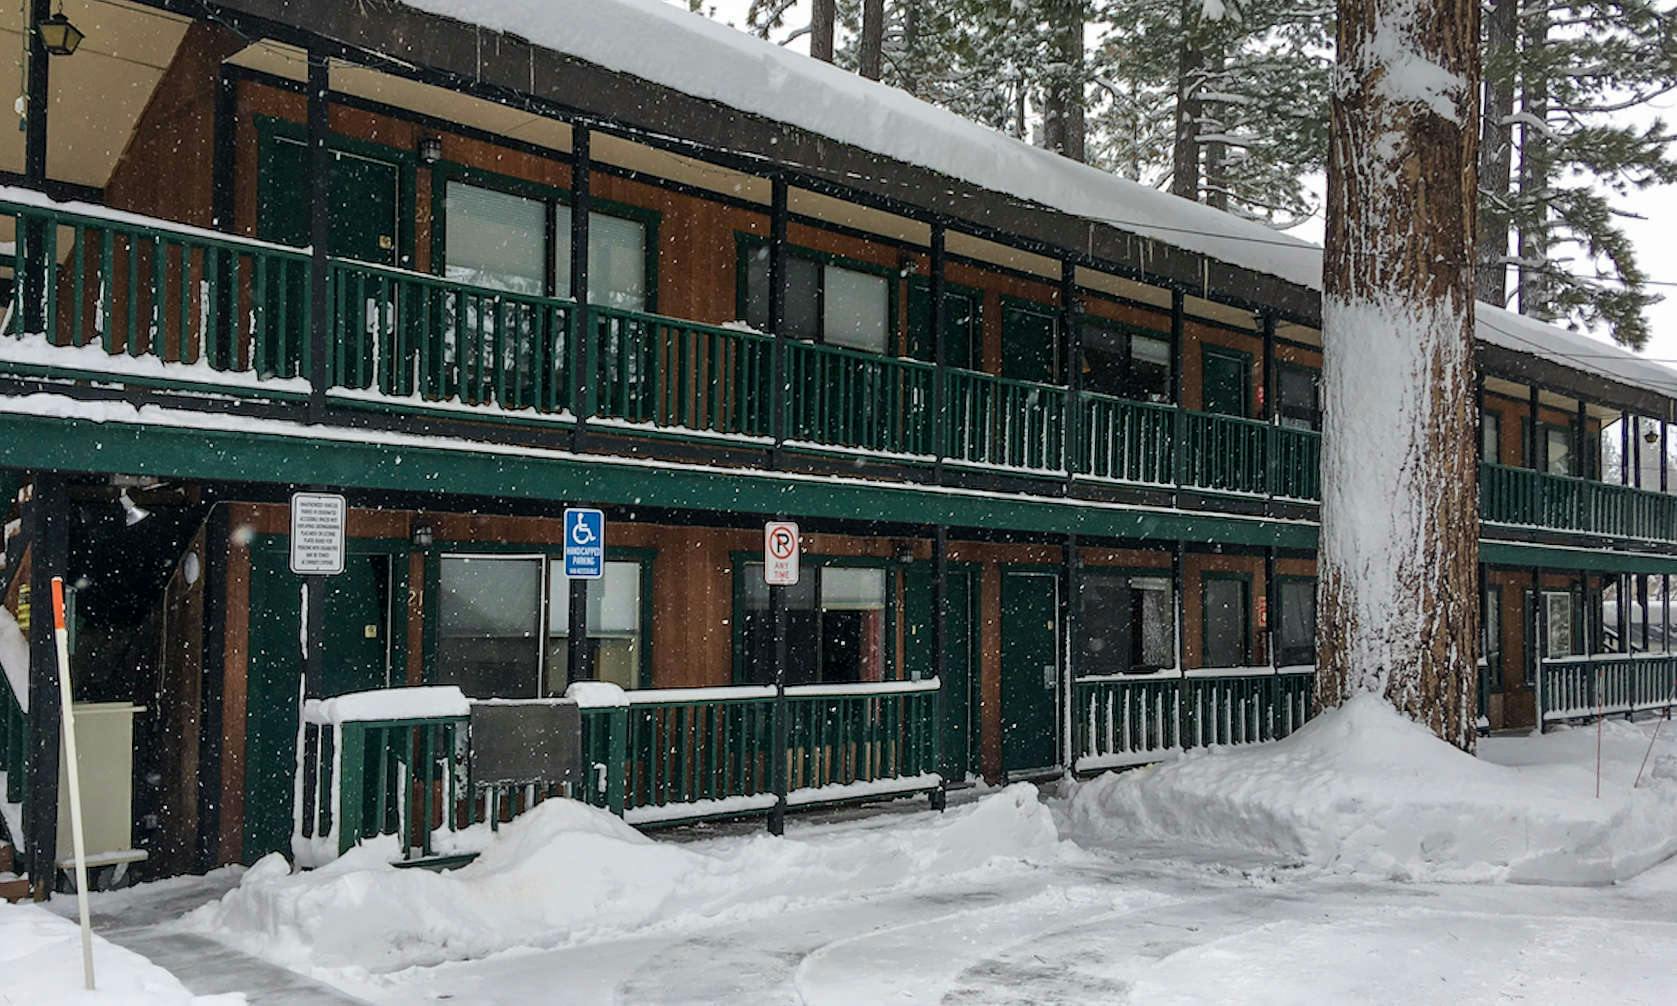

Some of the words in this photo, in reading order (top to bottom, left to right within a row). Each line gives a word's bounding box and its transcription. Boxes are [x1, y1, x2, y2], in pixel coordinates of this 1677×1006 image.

[566, 546, 601, 557] HANDICAPPED
[572, 555, 596, 566] PARKING
[407, 590, 424, 607] 21
